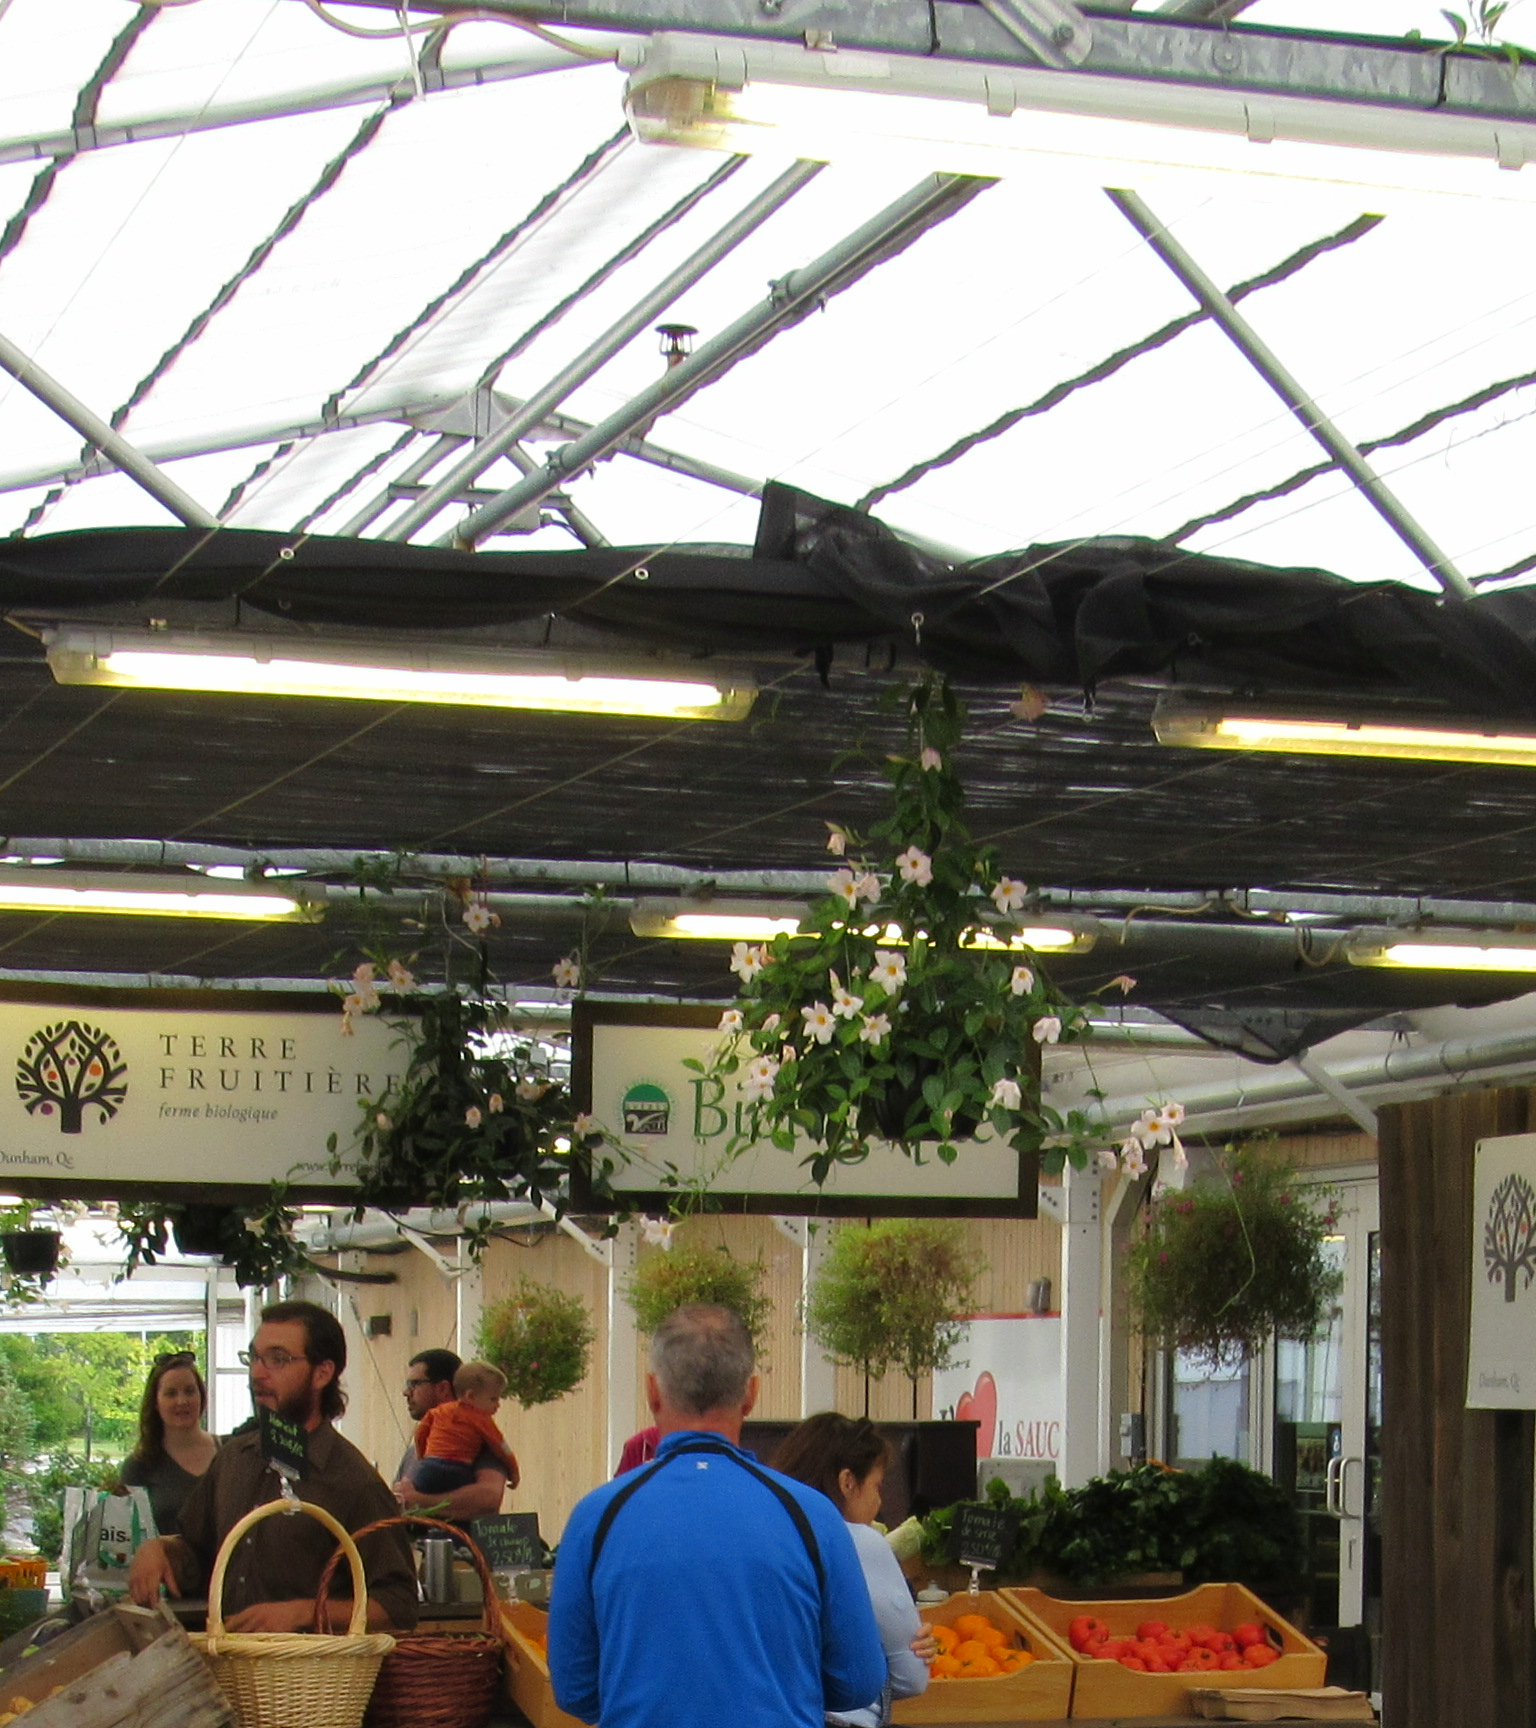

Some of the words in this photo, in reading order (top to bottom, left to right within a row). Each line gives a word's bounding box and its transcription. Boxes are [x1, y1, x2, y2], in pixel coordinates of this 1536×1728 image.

[159, 1033, 297, 1060] TERRE
[159, 1066, 402, 1096] FRUITIÈRE
[158, 1102, 200, 1119] ferme
[205, 1102, 279, 1124] biologique
[56, 1151, 75, 1170] Qc
[997, 1420, 1011, 1456] la
